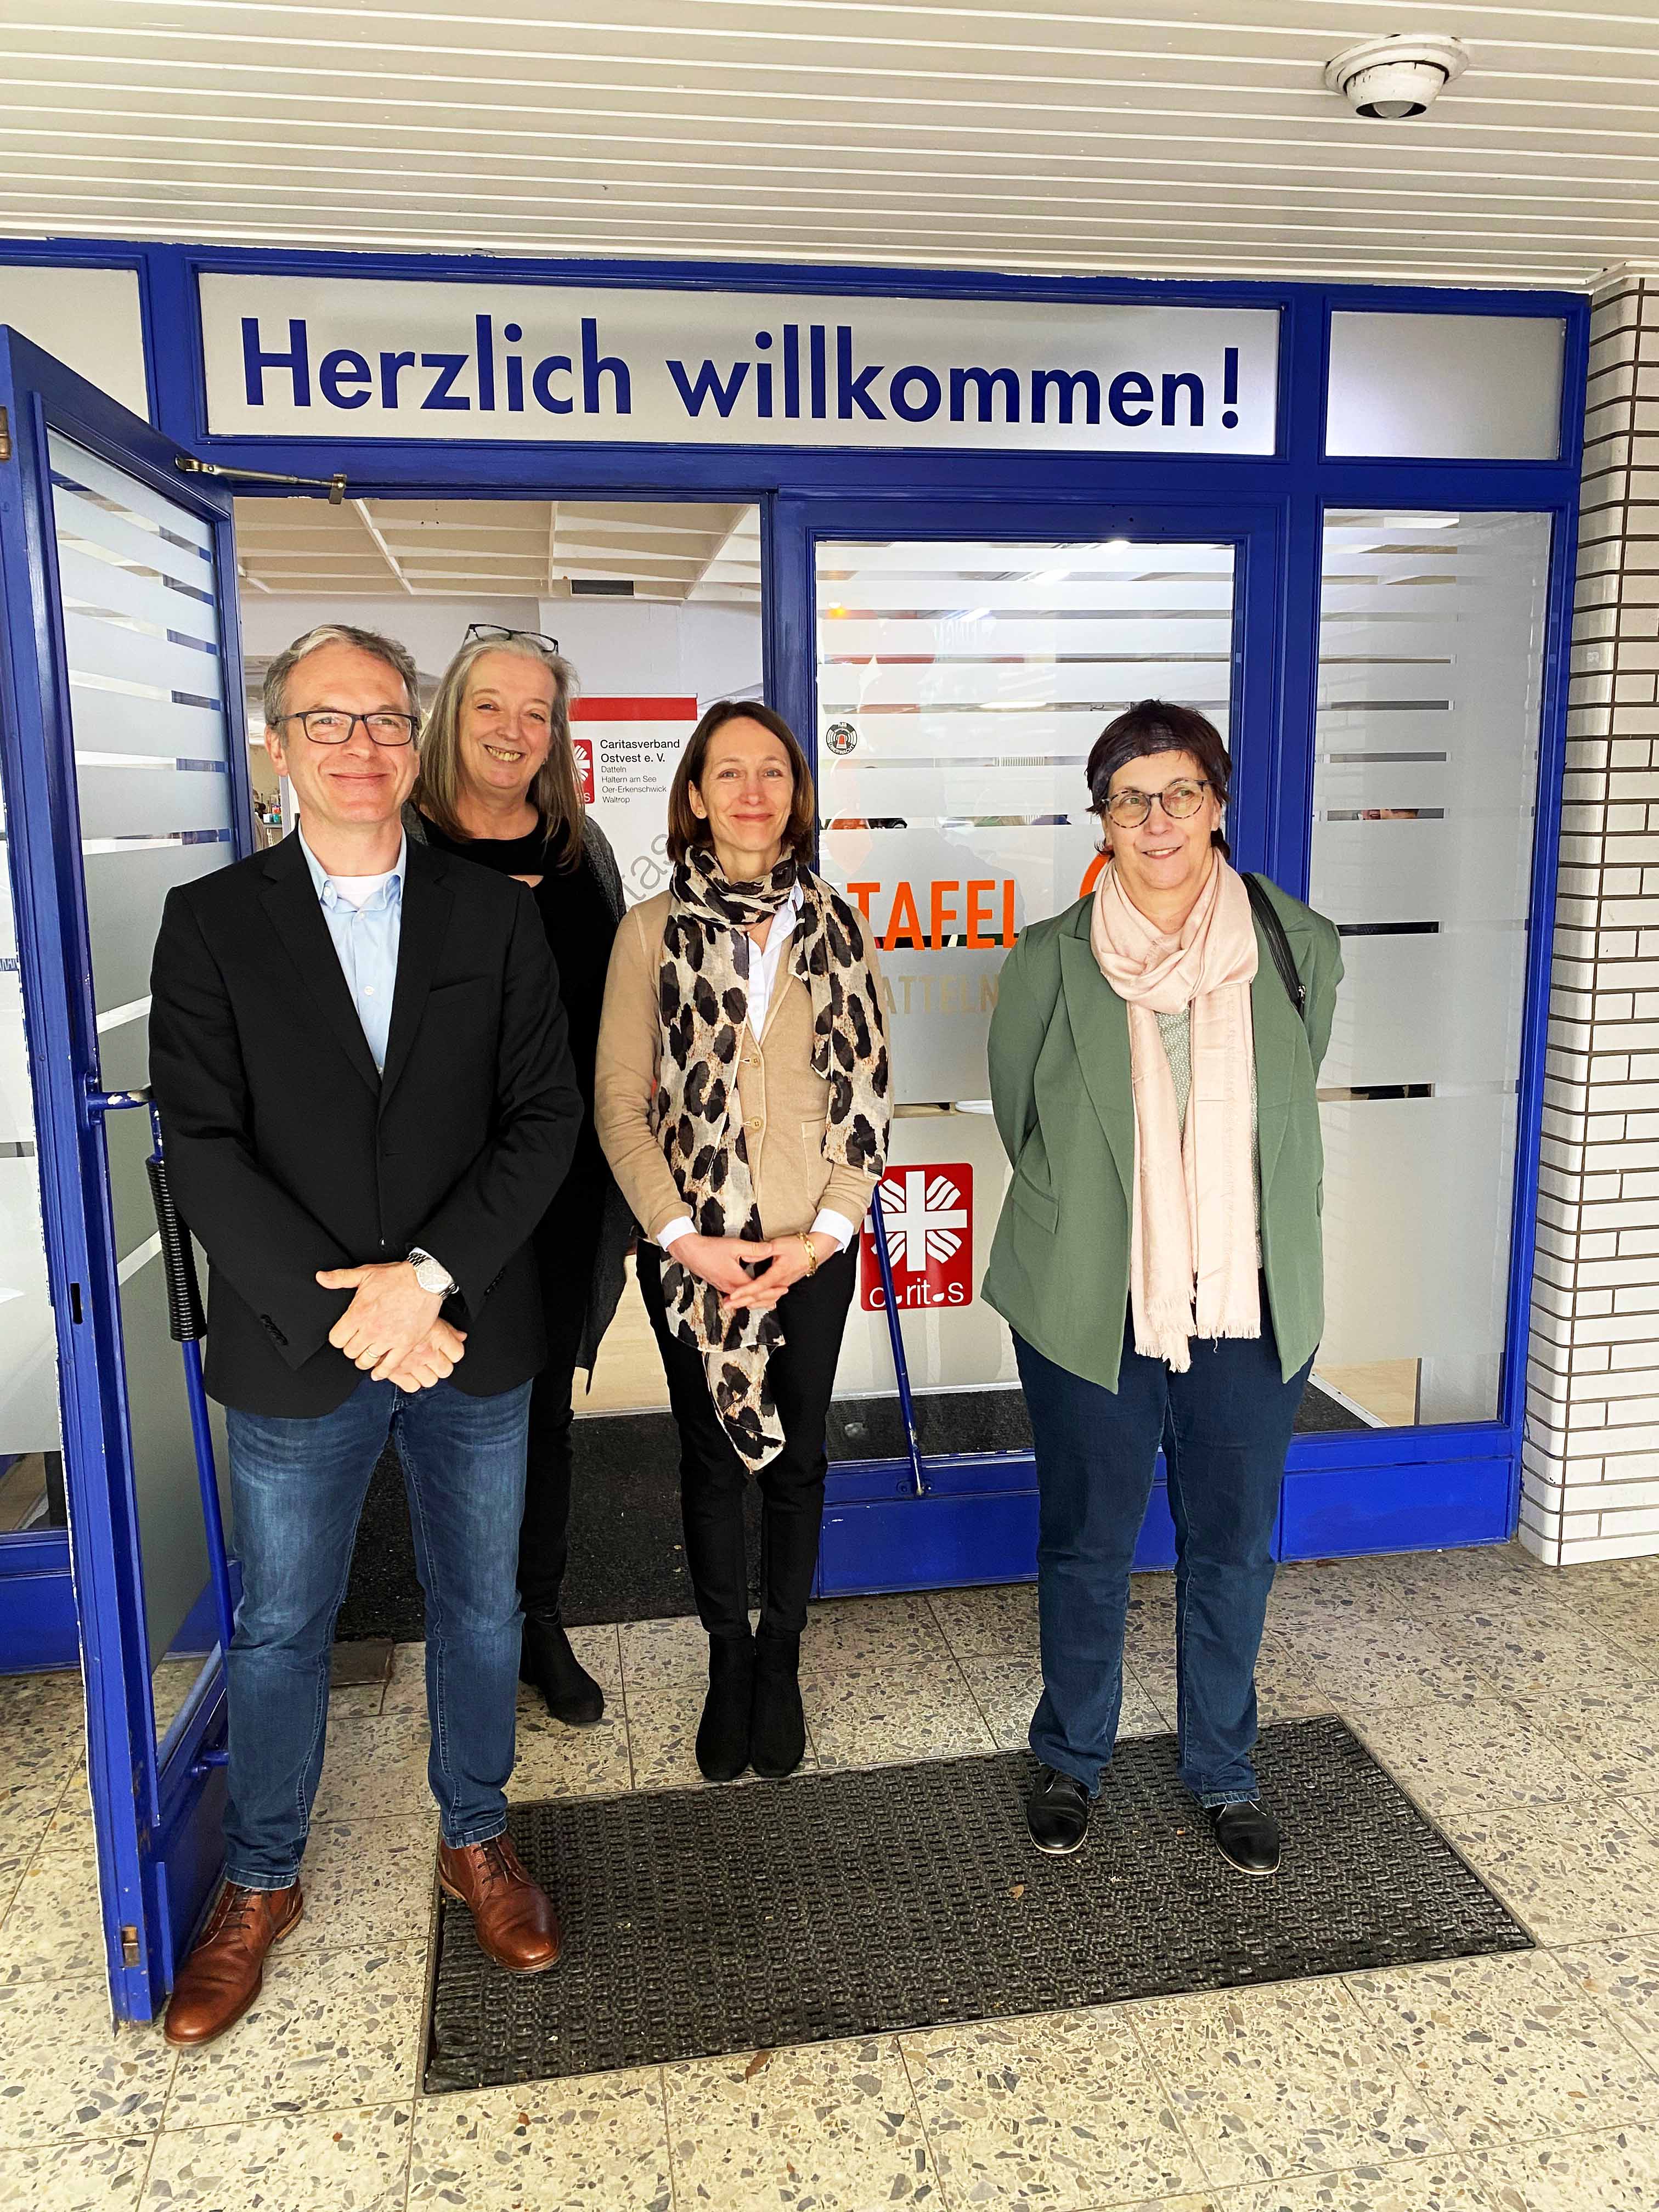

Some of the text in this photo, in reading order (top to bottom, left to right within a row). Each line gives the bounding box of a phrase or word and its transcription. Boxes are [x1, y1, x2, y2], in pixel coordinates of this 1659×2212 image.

[241, 314, 1239, 429] Herzlich willkommen!
[600, 739, 680, 749] Caritasverband
[601, 754, 641, 763] Ostvest
[657, 753, 665, 762] V.
[847, 879, 1018, 951] TAFEL
[881, 974, 999, 1014] ATTELN
